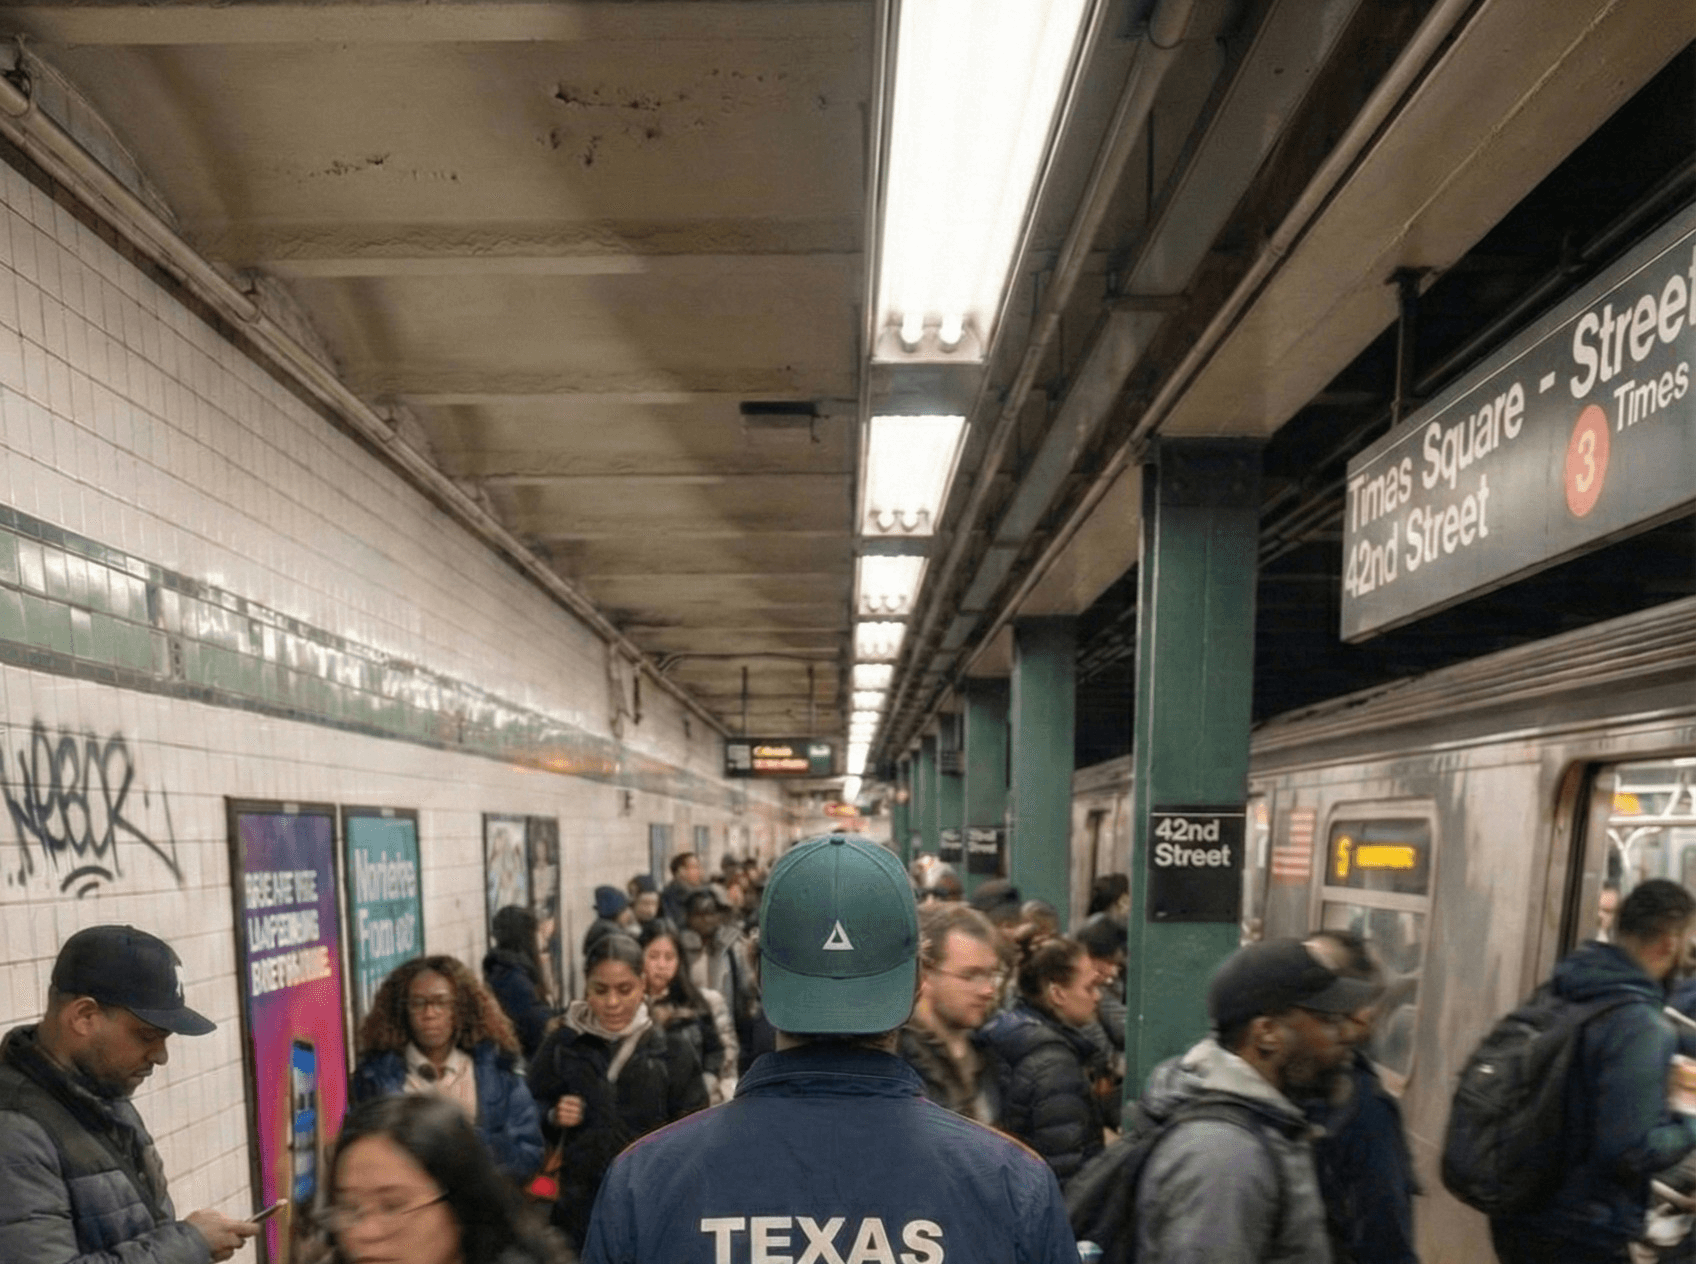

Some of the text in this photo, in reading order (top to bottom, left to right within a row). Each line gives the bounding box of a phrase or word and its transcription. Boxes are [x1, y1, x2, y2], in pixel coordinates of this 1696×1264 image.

[1613, 361, 1690, 432] Times
[1422, 382, 1525, 490] Square
[1574, 429, 1597, 494] 3
[1345, 472, 1491, 599] 42nd Street
[1154, 843, 1232, 868] Street
[1155, 817, 1221, 842] 42nd
